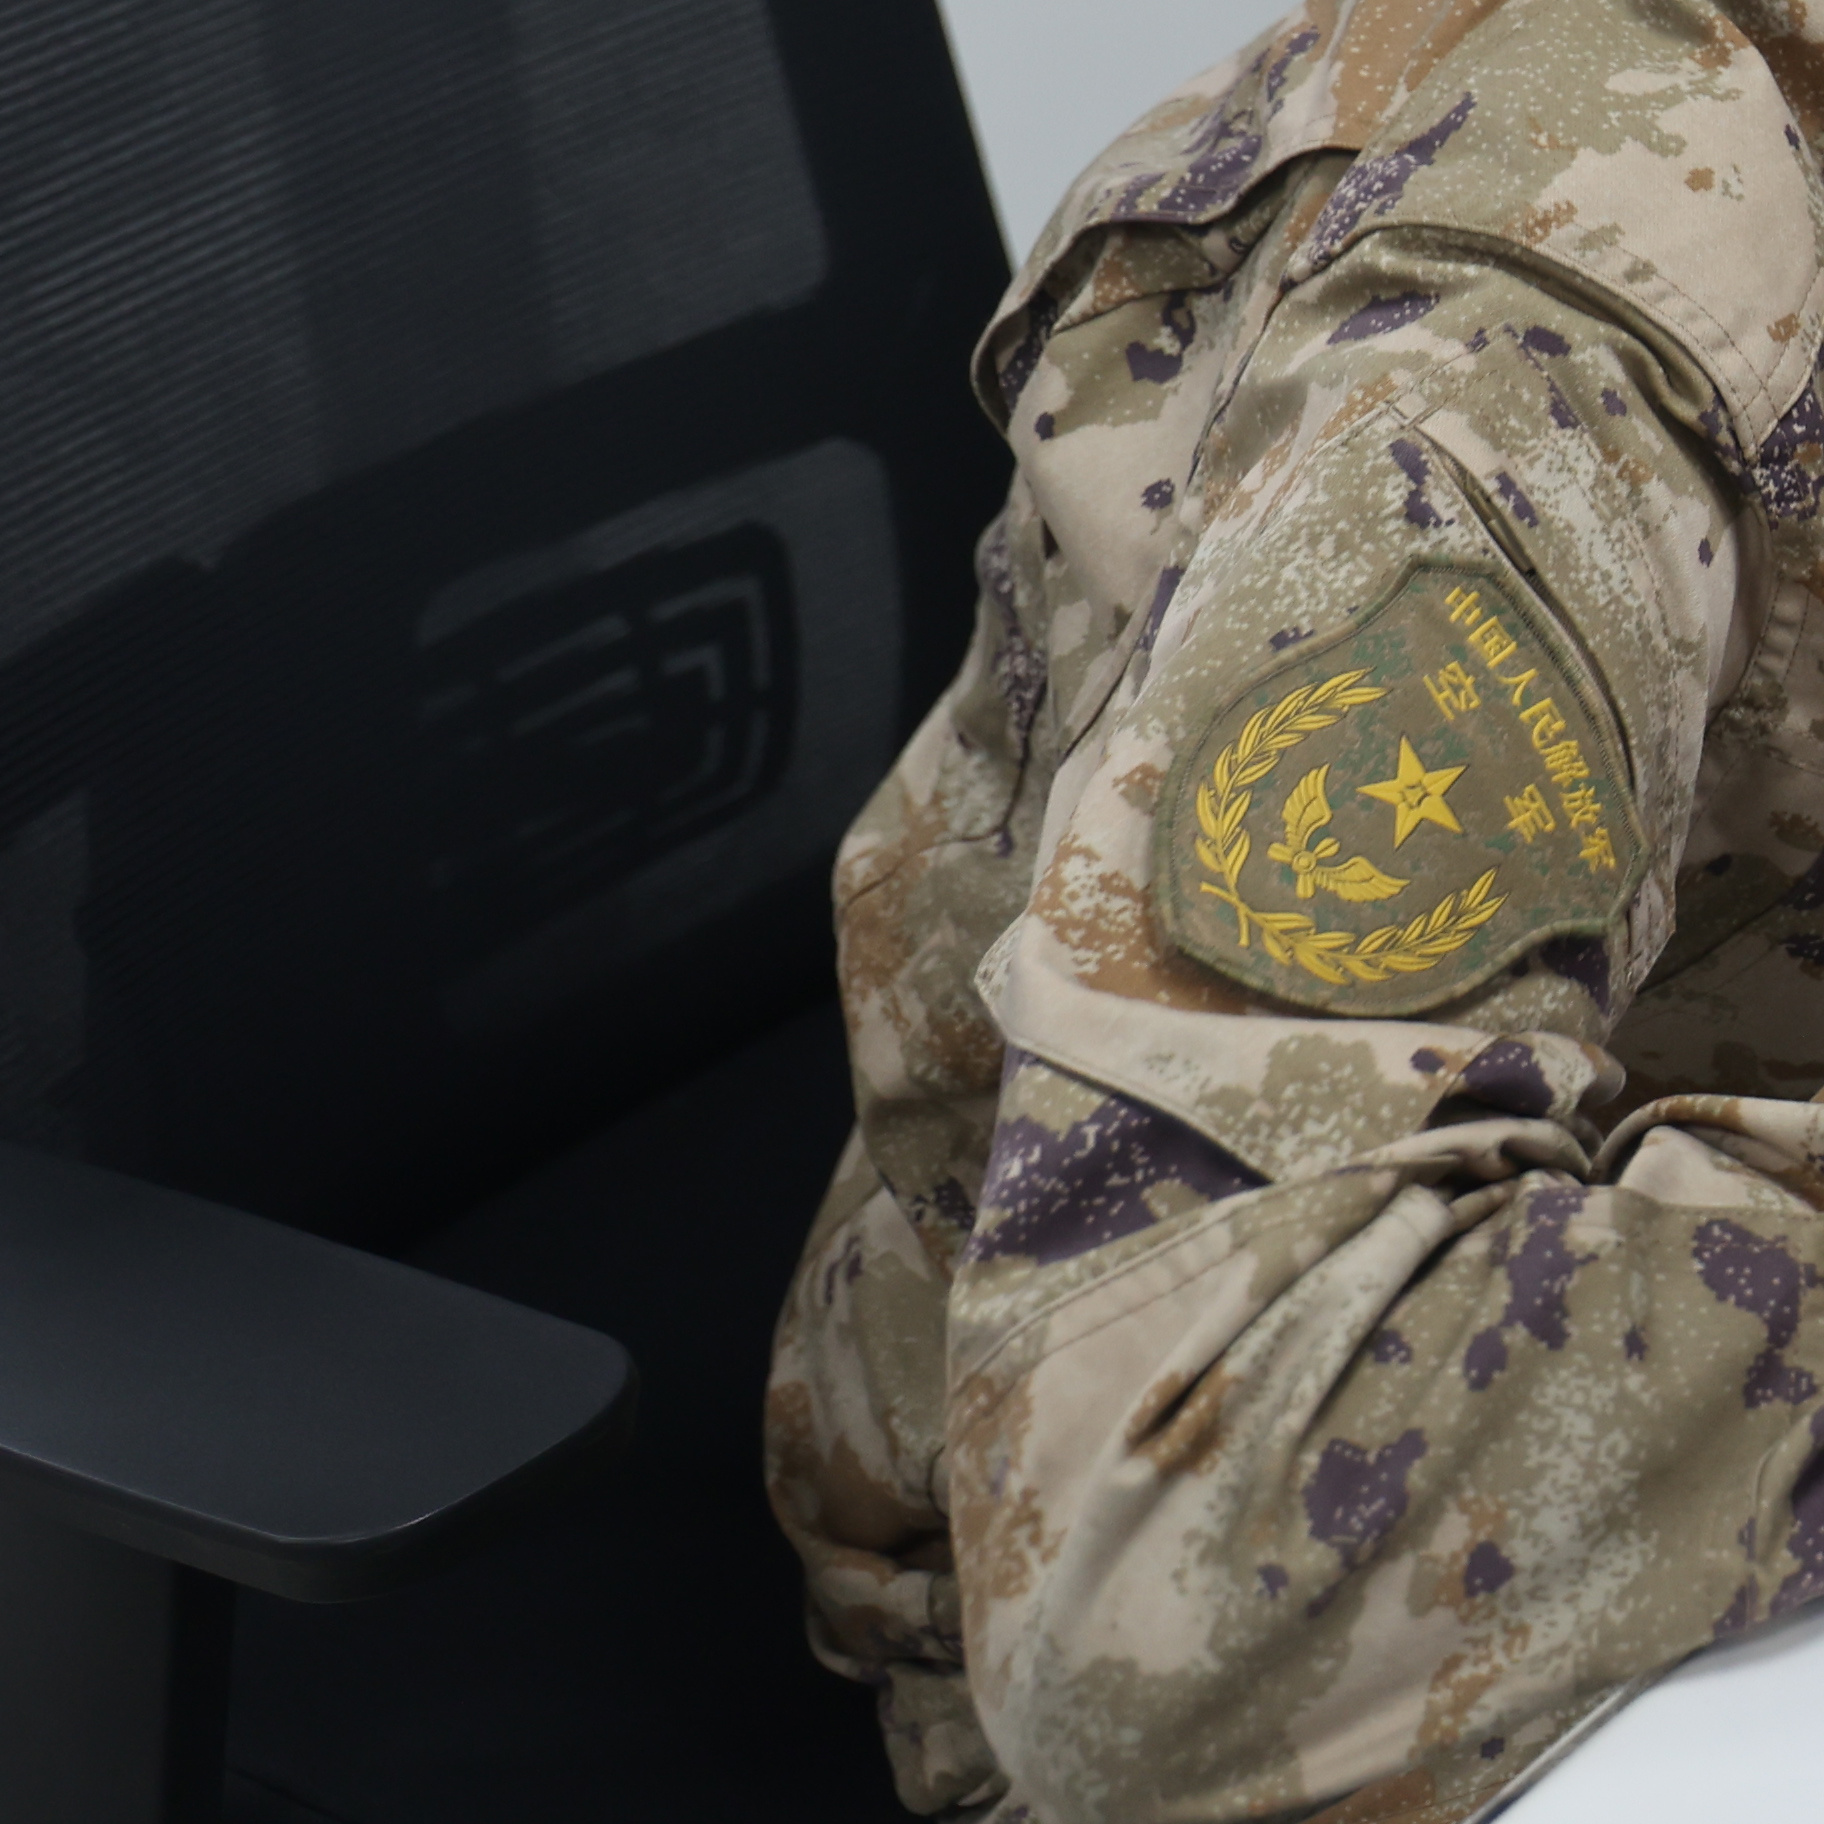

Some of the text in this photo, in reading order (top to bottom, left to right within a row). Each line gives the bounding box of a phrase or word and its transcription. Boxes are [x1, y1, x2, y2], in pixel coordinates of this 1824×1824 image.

[1443, 587, 1618, 872] 中国人民解放军
